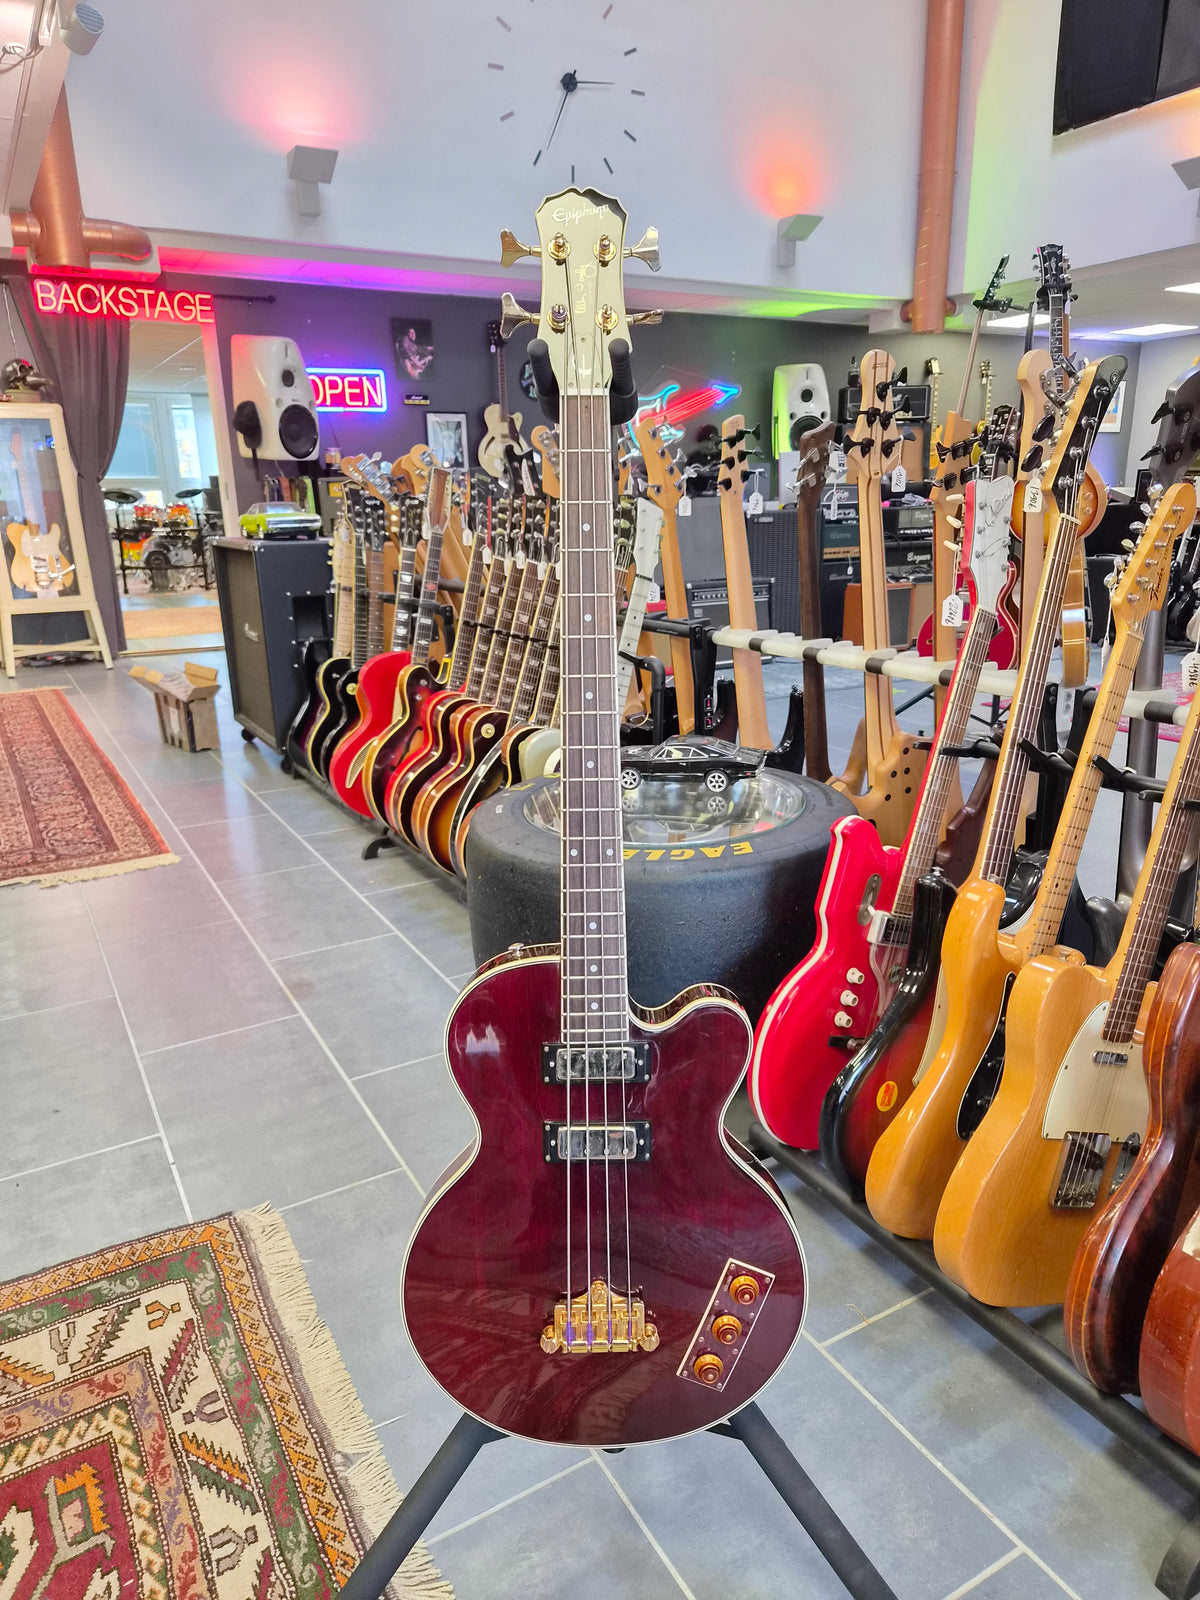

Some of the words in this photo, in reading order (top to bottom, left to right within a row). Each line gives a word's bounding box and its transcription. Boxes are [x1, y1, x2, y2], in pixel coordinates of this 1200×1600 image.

[34, 279, 215, 323] BACKSTAGE
[308, 374, 383, 407] OPEN
[623, 841, 754, 861] EAGLE
